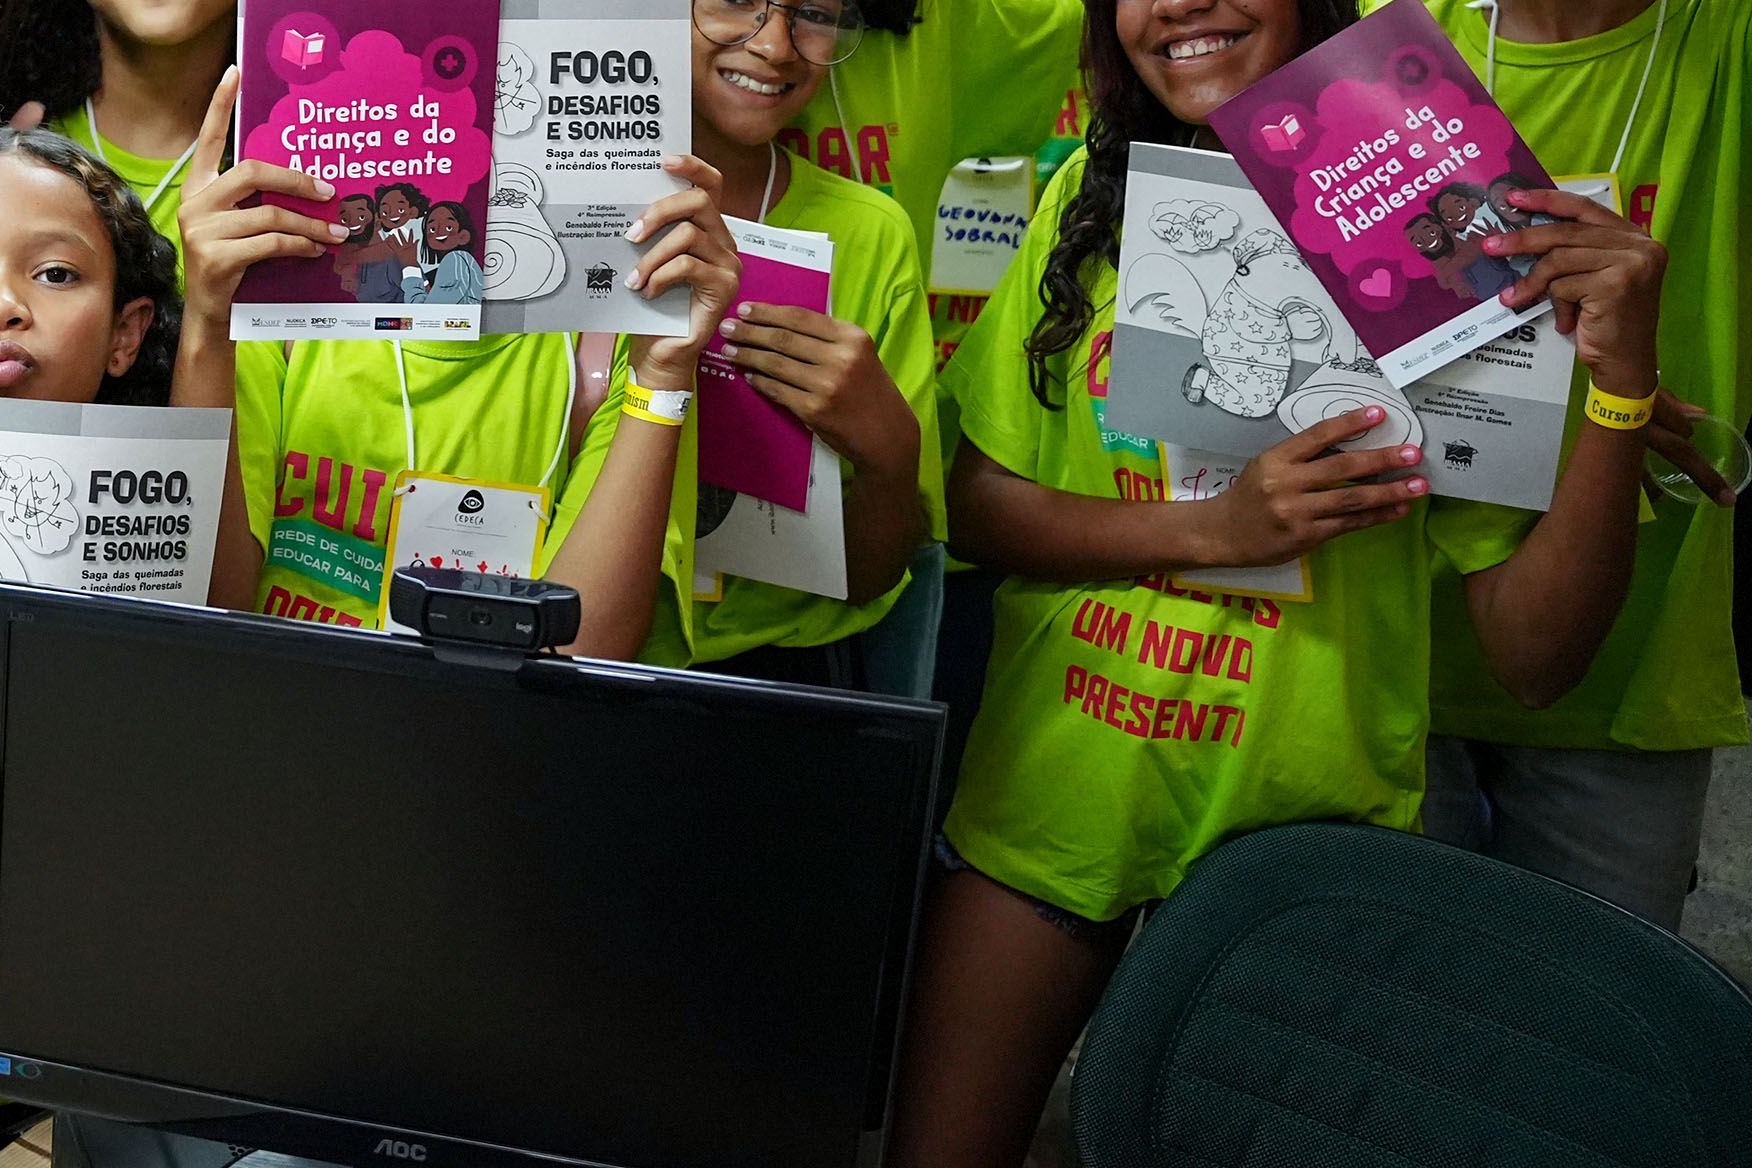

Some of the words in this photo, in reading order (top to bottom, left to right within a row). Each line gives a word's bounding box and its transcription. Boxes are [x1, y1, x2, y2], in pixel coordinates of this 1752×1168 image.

[550, 50, 659, 86] FOGO,
[298, 98, 398, 124] Direitos
[409, 94, 440, 118] da
[548, 94, 660, 115] DESAFIOS
[281, 124, 381, 154] Criança
[394, 129, 410, 146] e
[422, 118, 456, 144] do
[547, 122, 560, 140] E
[568, 120, 660, 140] SONHOS
[546, 148, 574, 160] Saga
[579, 148, 599, 157] das
[604, 148, 661, 160] queimadas
[1309, 128, 1400, 192] Direitos
[1404, 105, 1436, 130] da
[289, 150, 452, 180] Adolescente
[556, 161, 607, 170] incêndios
[611, 161, 661, 170] florestais
[1314, 156, 1404, 218] Criança
[1408, 143, 1427, 160] e
[1431, 117, 1464, 143] do
[1335, 142, 1481, 242] Adolescente
[565, 221, 602, 229] Genebaldo
[1475, 353, 1533, 370] florestais
[1424, 397, 1463, 411] Genebaldo
[1464, 403, 1488, 414] Freire
[1488, 408, 1505, 417] Dias
[1592, 399, 1630, 423] Curso
[88, 470, 192, 506] FOGO,
[85, 514, 190, 536] DESAFIOS
[454, 513, 485, 525] CEDECA
[82, 542, 97, 561] E
[103, 540, 187, 562] SONHOS
[275, 530, 316, 546] REDE
[319, 540, 339, 555] DE
[343, 549, 385, 573] CUIDA
[81, 570, 108, 582] Saga
[112, 570, 130, 579] das
[134, 568, 184, 581] queimadas
[273, 547, 331, 572] EDUCAR
[333, 565, 371, 591] PARA
[90, 583, 136, 592] incêndios
[139, 581, 182, 592] florestais
[1072, 597, 1133, 653] UM
[1138, 619, 1254, 684] NOVO
[373, 1139, 427, 1161] AOC
